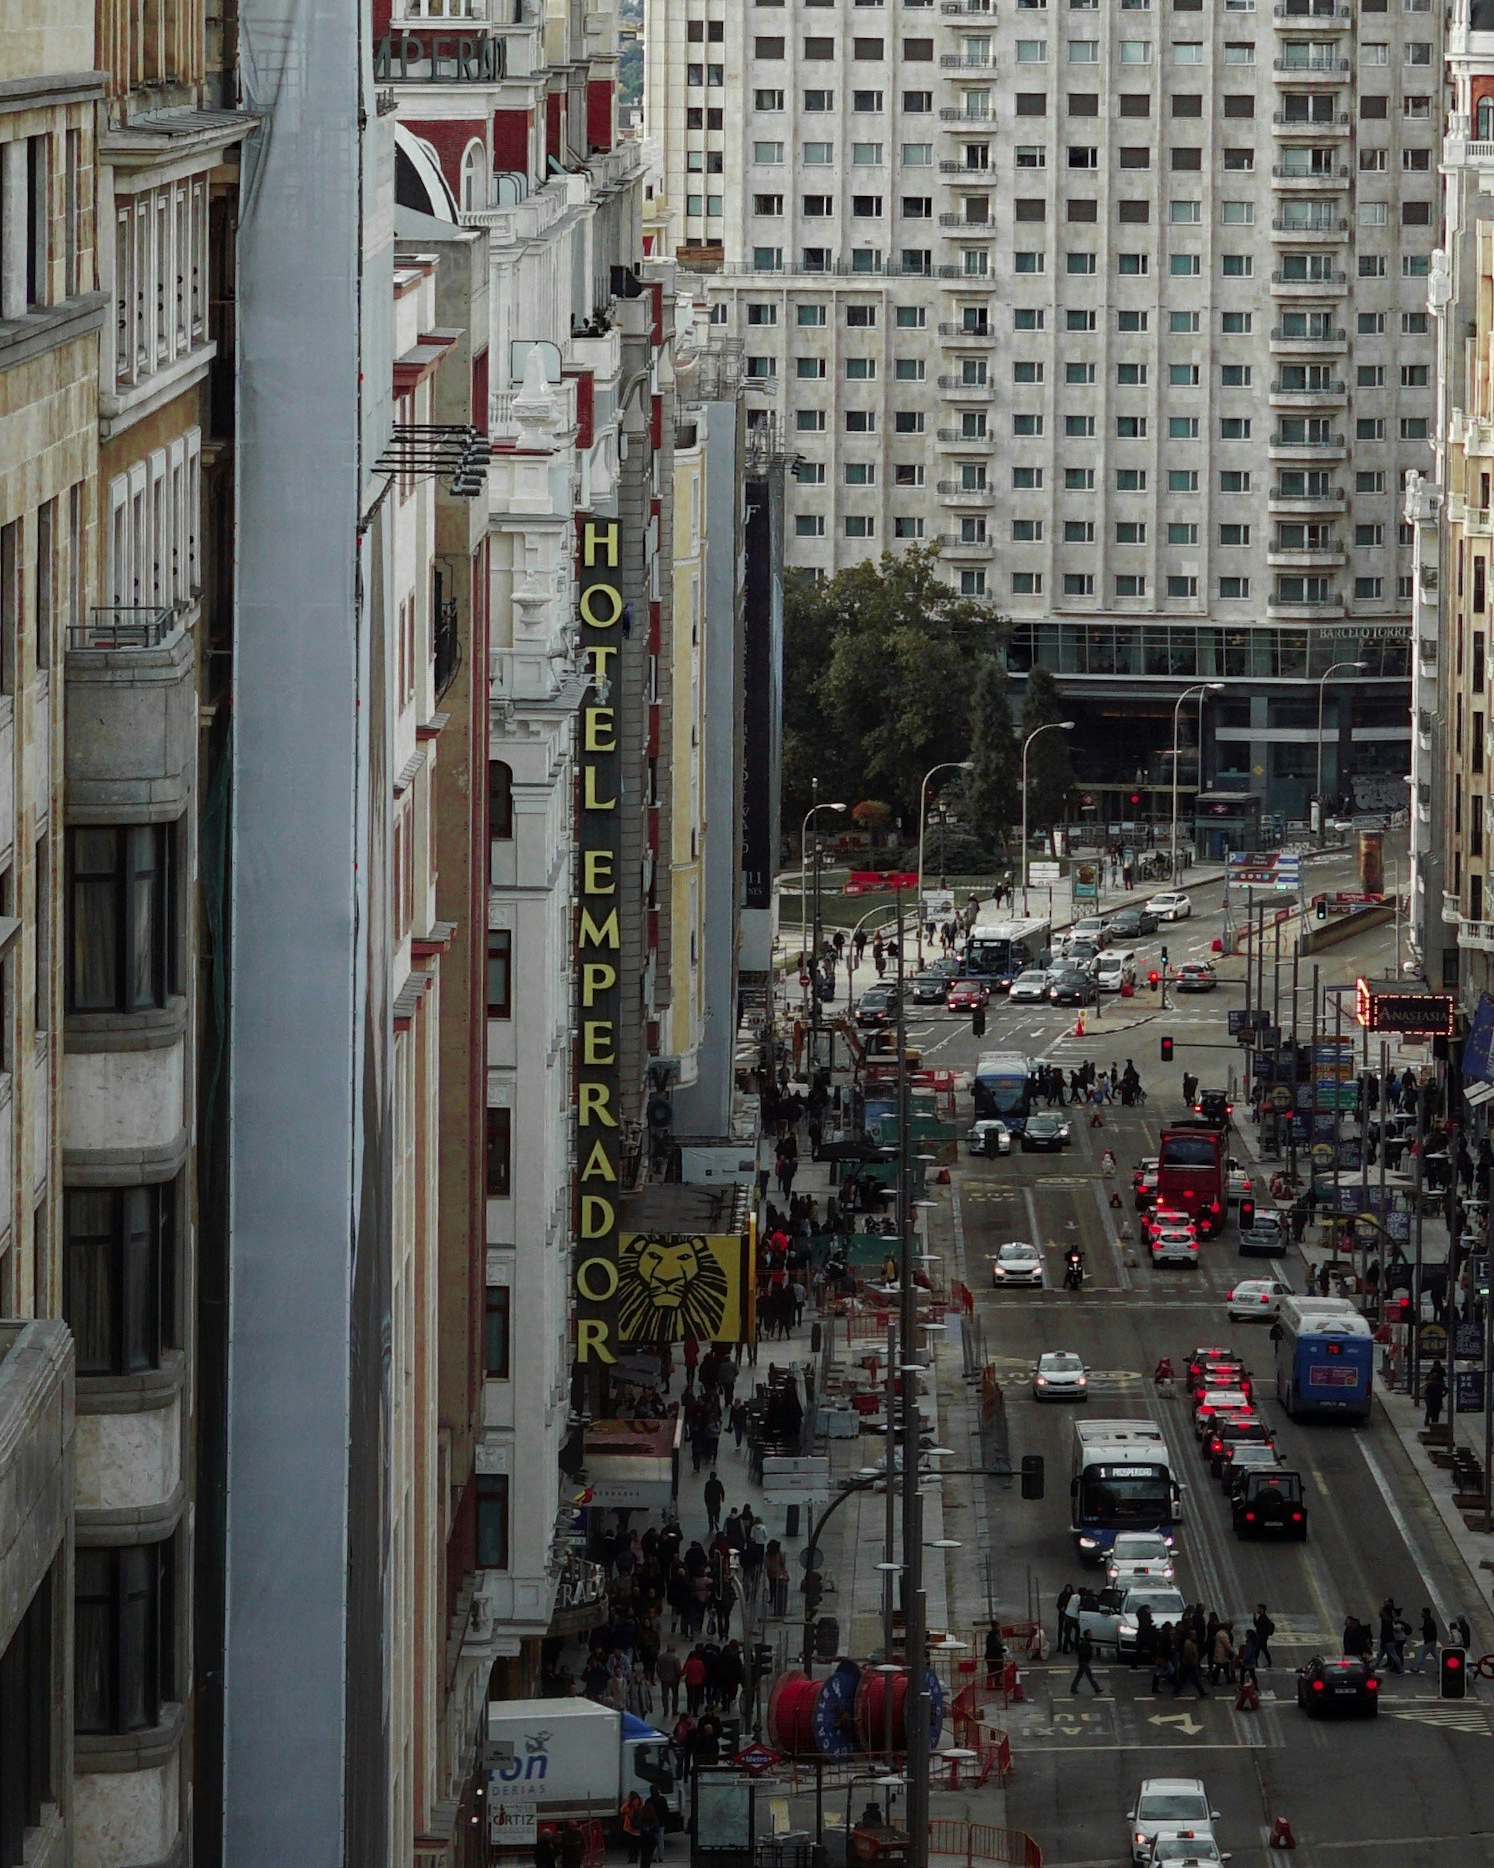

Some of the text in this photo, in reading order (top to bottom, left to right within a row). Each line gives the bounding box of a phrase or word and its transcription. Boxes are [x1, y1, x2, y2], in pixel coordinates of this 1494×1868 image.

[577, 523, 622, 1363] HOTEL EMPERADOR
[1378, 1006, 1448, 1021] ANASTASIA
[745, 1755, 769, 1763] Metro
